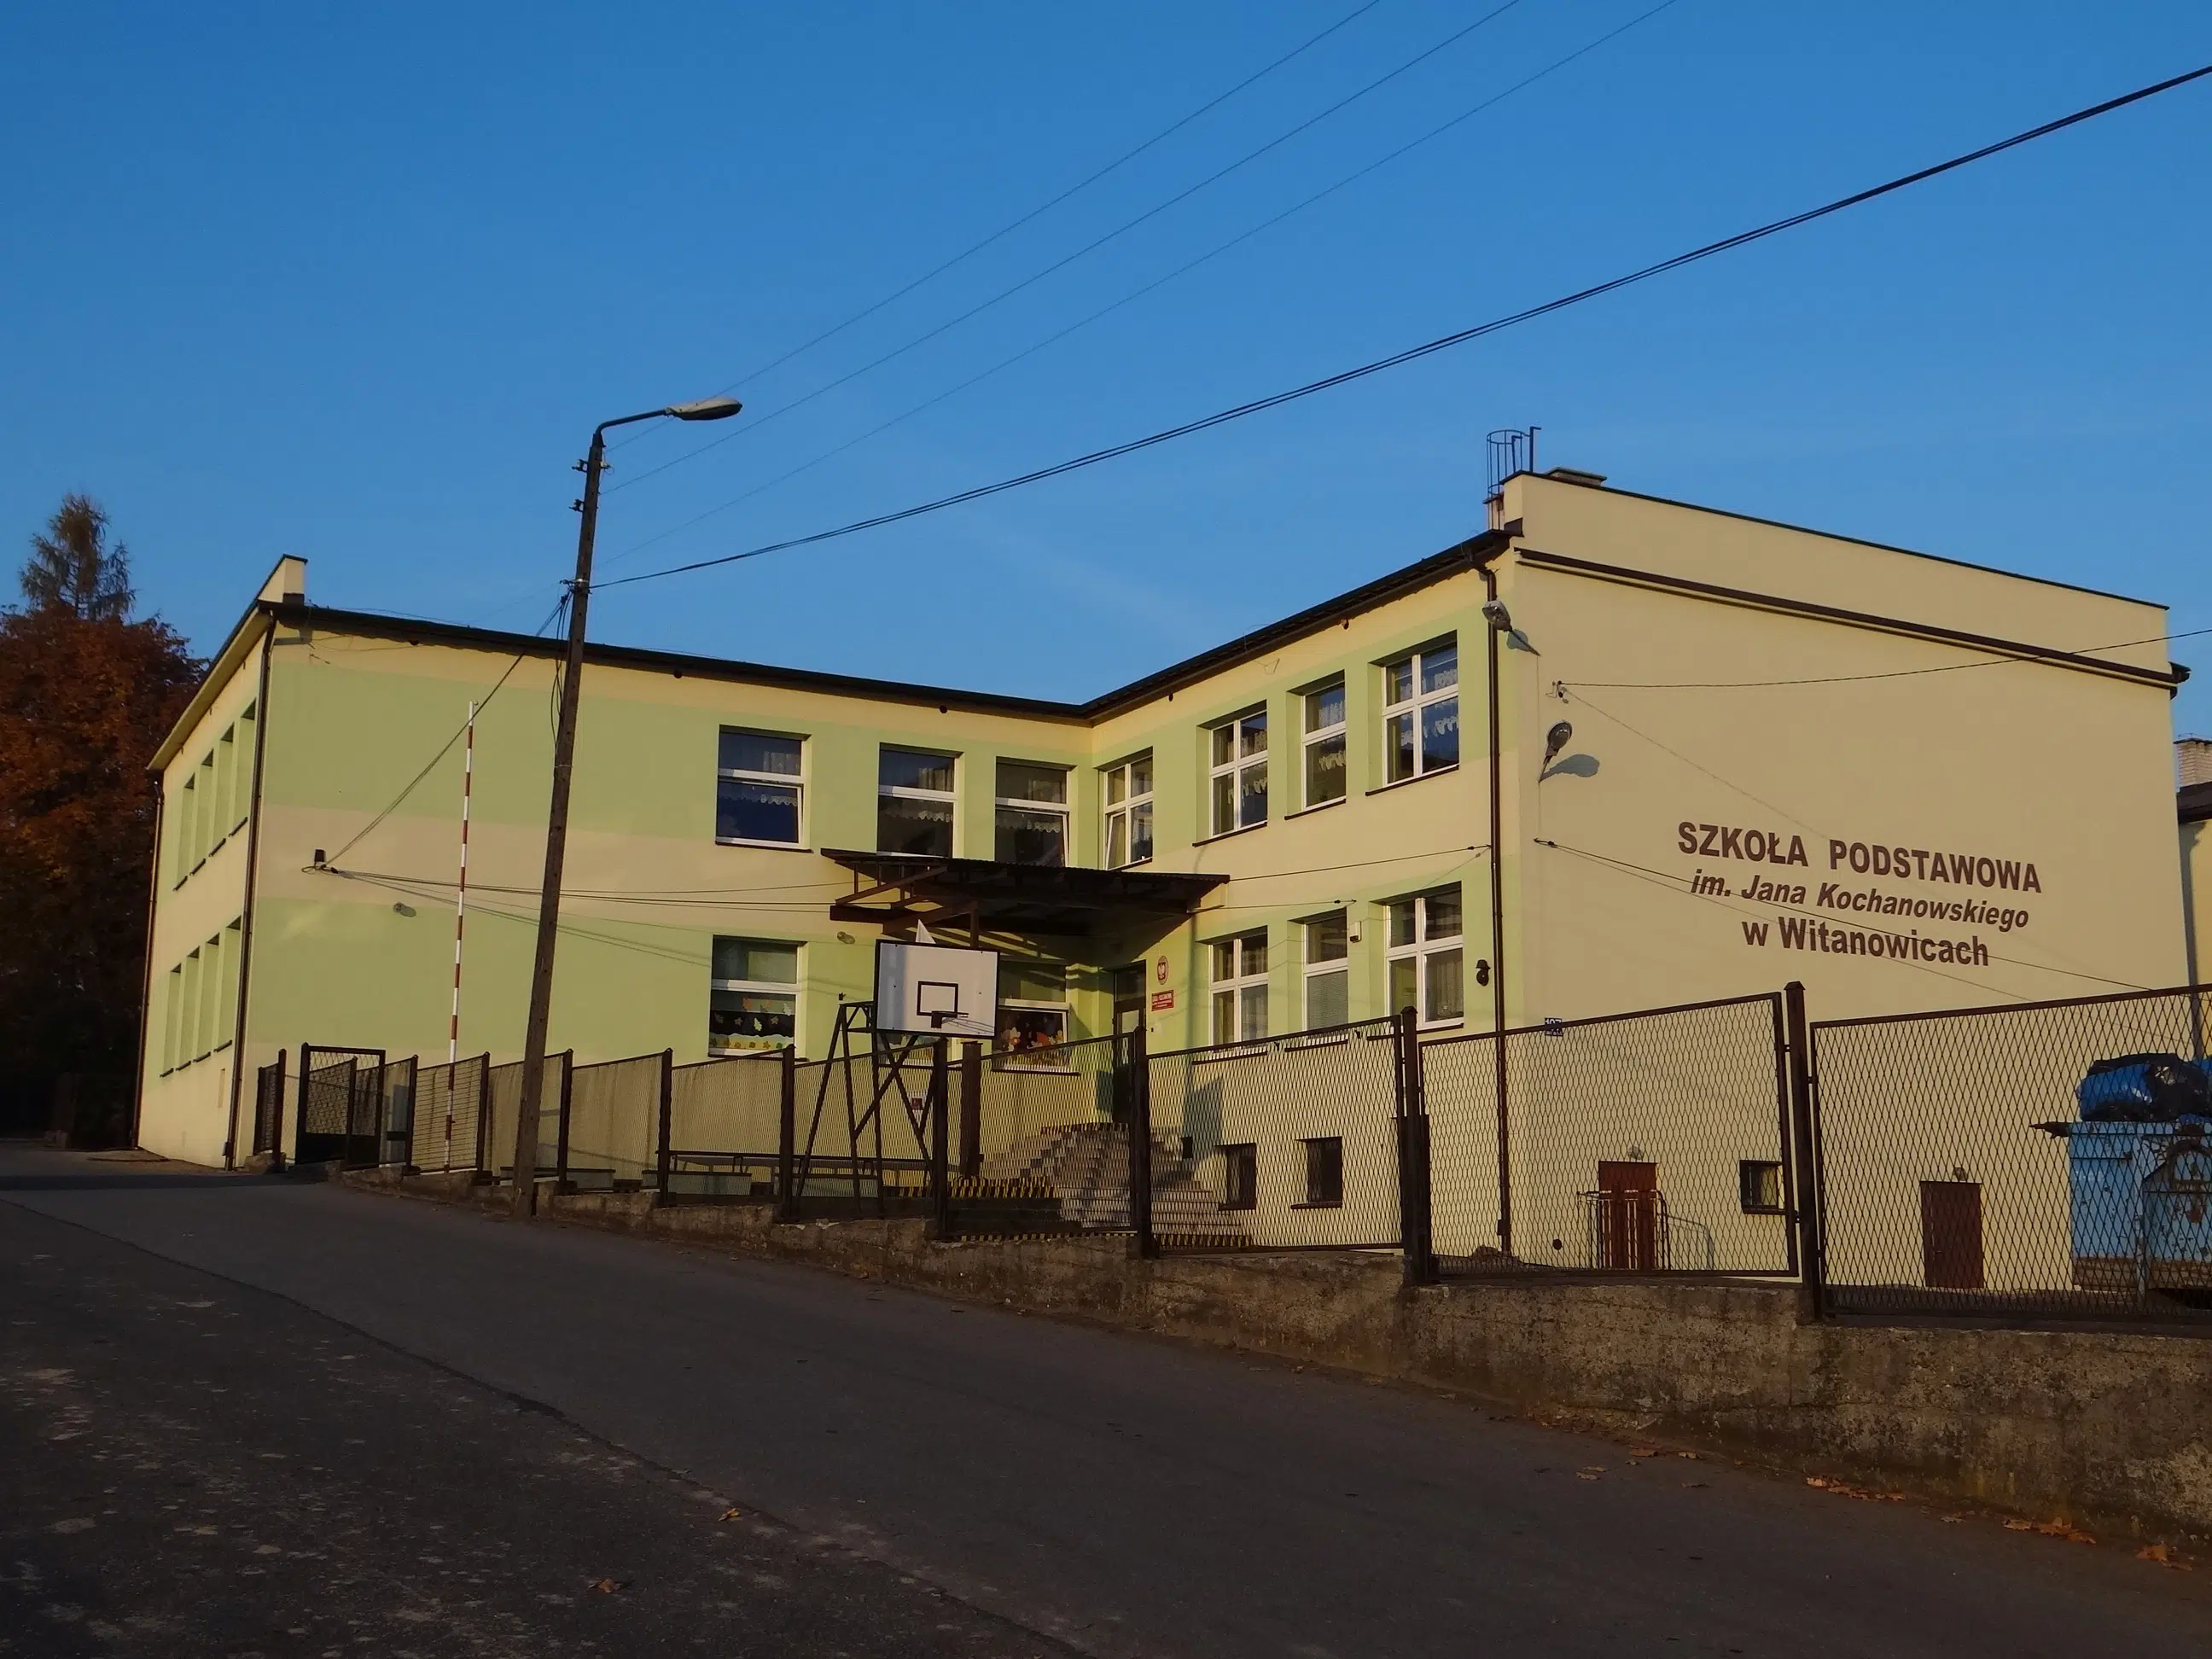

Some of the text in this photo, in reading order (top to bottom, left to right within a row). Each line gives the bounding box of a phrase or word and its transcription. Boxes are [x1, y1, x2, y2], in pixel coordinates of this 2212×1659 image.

[1678, 821, 2042, 894] SZKOŁA PODSTAWOWA
[1691, 868, 2029, 933] im. Jana Kochanowskiego
[1741, 916, 1989, 967] w Witanowicach
